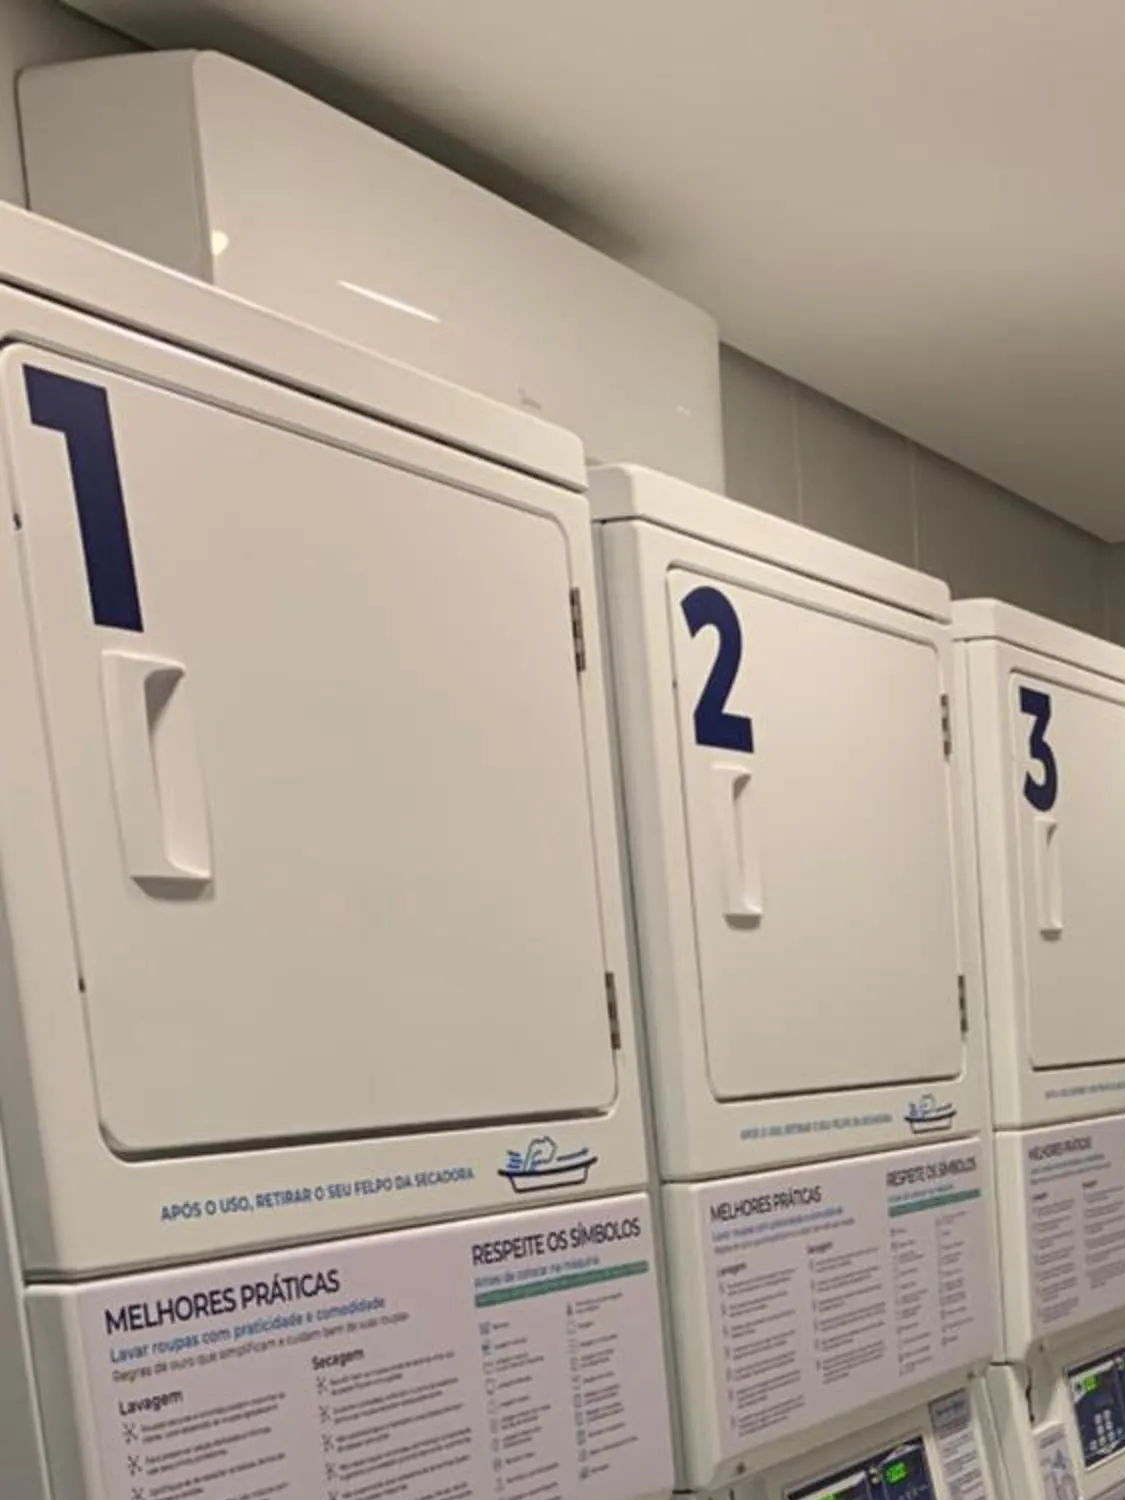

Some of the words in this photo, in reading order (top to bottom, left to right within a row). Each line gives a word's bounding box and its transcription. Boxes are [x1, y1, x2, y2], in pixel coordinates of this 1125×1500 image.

[22, 363, 144, 633] 1
[680, 586, 755, 753] 2
[1018, 685, 1058, 812] 3
[161, 1196, 201, 1221] APÓS
[204, 1200, 217, 1215] O
[256, 1187, 311, 1208] RETIRAR
[314, 1186, 325, 1201] O
[327, 1182, 352, 1199] SEU
[354, 1177, 393, 1196] FELPO
[395, 1174, 414, 1190] DA
[415, 1167, 475, 1187] SECADORA
[472, 1233, 545, 1266] RESPEITE
[546, 1230, 569, 1252] OS
[570, 1217, 641, 1248] SÍMBOLOS
[104, 1287, 237, 1335] MELHORES
[240, 1269, 341, 1310] PRÁTICAS
[109, 1345, 148, 1364] Lavar
[151, 1336, 199, 1358] roupas
[202, 1329, 231, 1346] com
[233, 1311, 303, 1342] praticidade
[312, 1349, 365, 1371] Secagem
[118, 1391, 183, 1417] Lavagem
